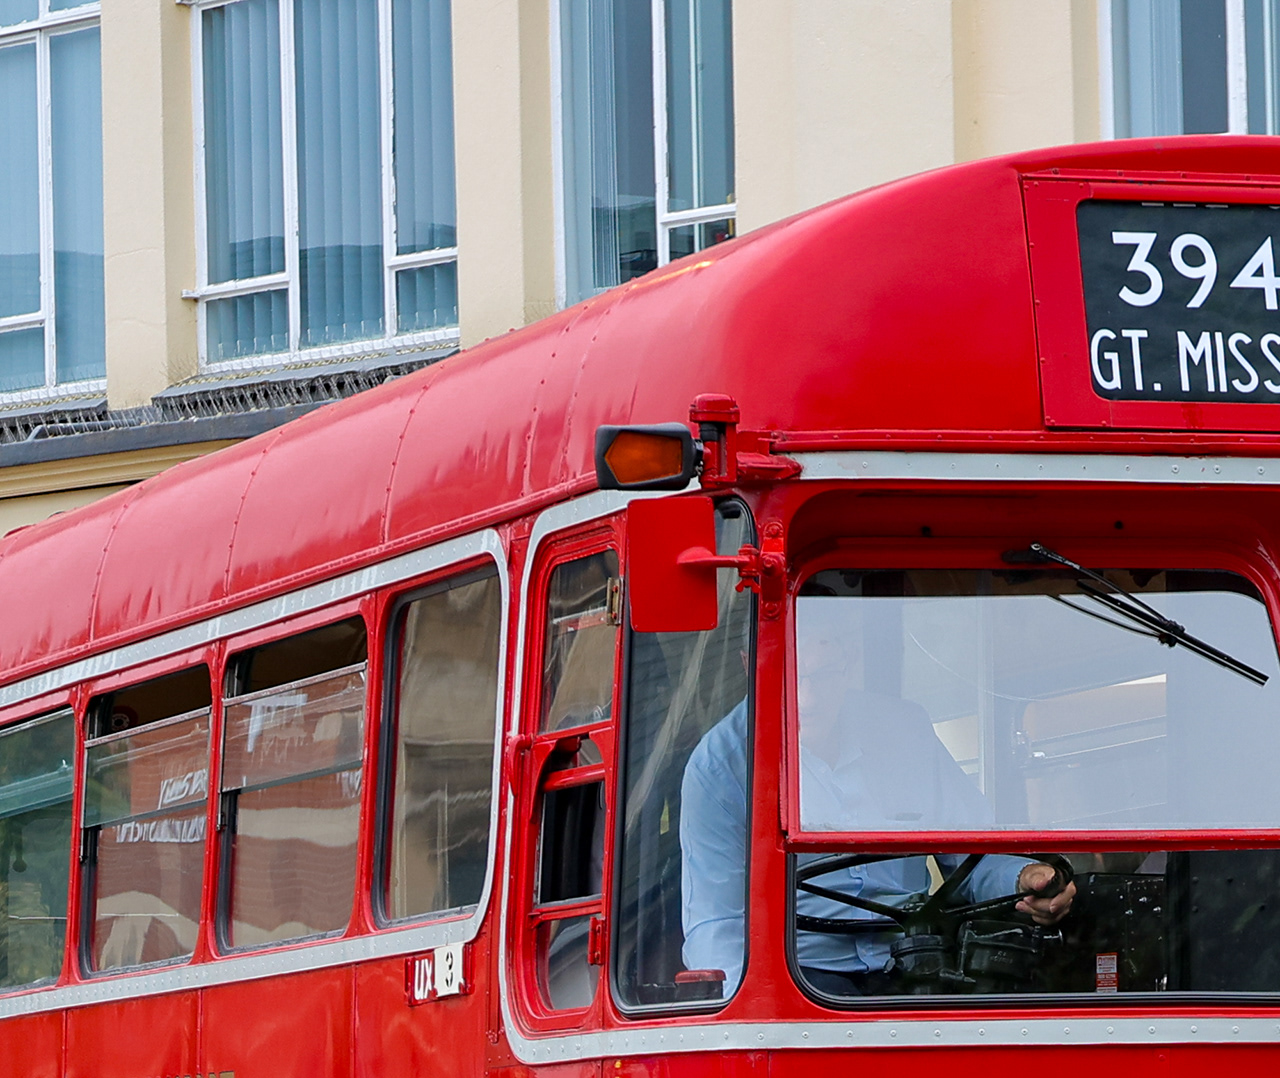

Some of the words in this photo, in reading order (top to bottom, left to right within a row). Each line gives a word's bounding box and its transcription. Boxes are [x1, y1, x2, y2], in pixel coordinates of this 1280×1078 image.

[1090, 328, 1162, 391] GT.
[414, 958, 433, 1000] UX
[445, 951, 454, 988] 3
